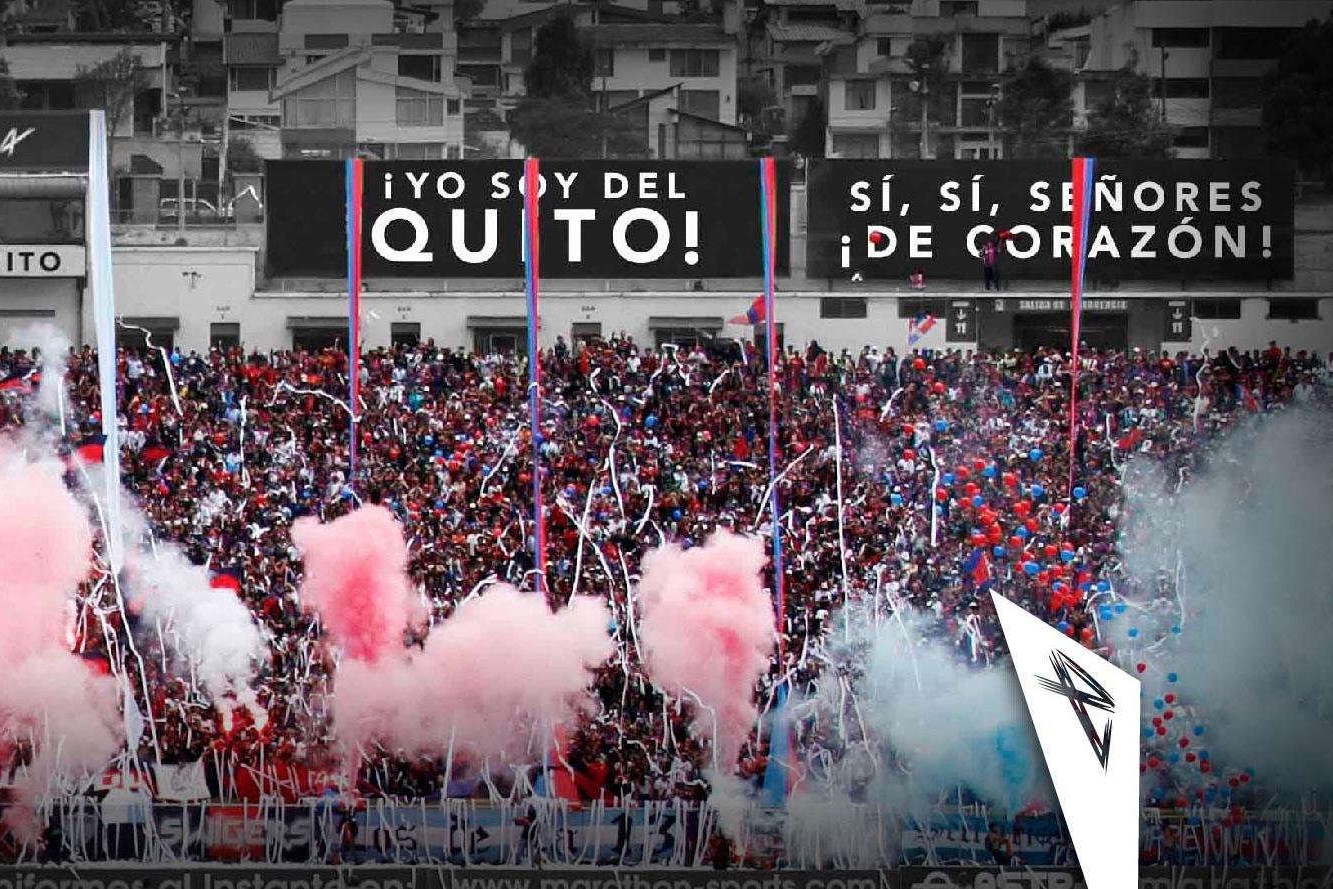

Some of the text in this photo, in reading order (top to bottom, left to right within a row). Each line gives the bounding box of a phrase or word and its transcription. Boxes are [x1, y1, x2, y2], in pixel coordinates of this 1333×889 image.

[603, 171, 687, 199] DEL
[849, 174, 1264, 217] SÍ, SÍ, SEÑORES
[965, 217, 1273, 259] CORAZÓN!
